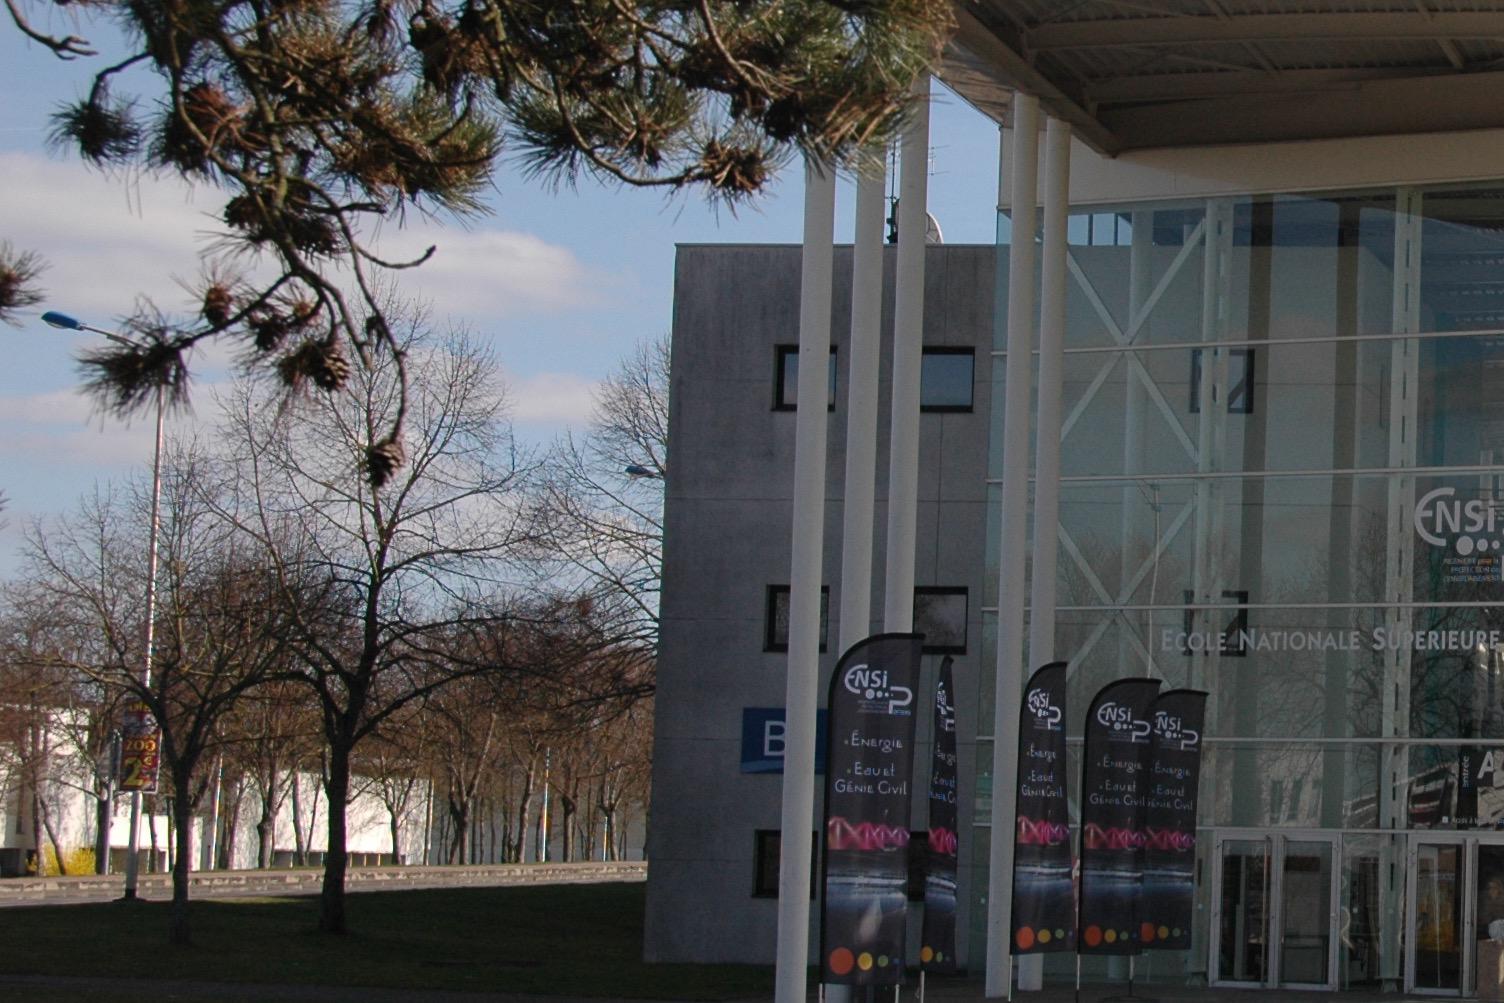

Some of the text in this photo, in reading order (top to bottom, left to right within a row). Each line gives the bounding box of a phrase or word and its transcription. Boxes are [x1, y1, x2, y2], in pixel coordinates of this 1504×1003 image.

[1161, 630, 1227, 650] ECOLE
[1239, 629, 1361, 650] NATIONALE
[1372, 627, 1500, 650] SUPERIEURE
